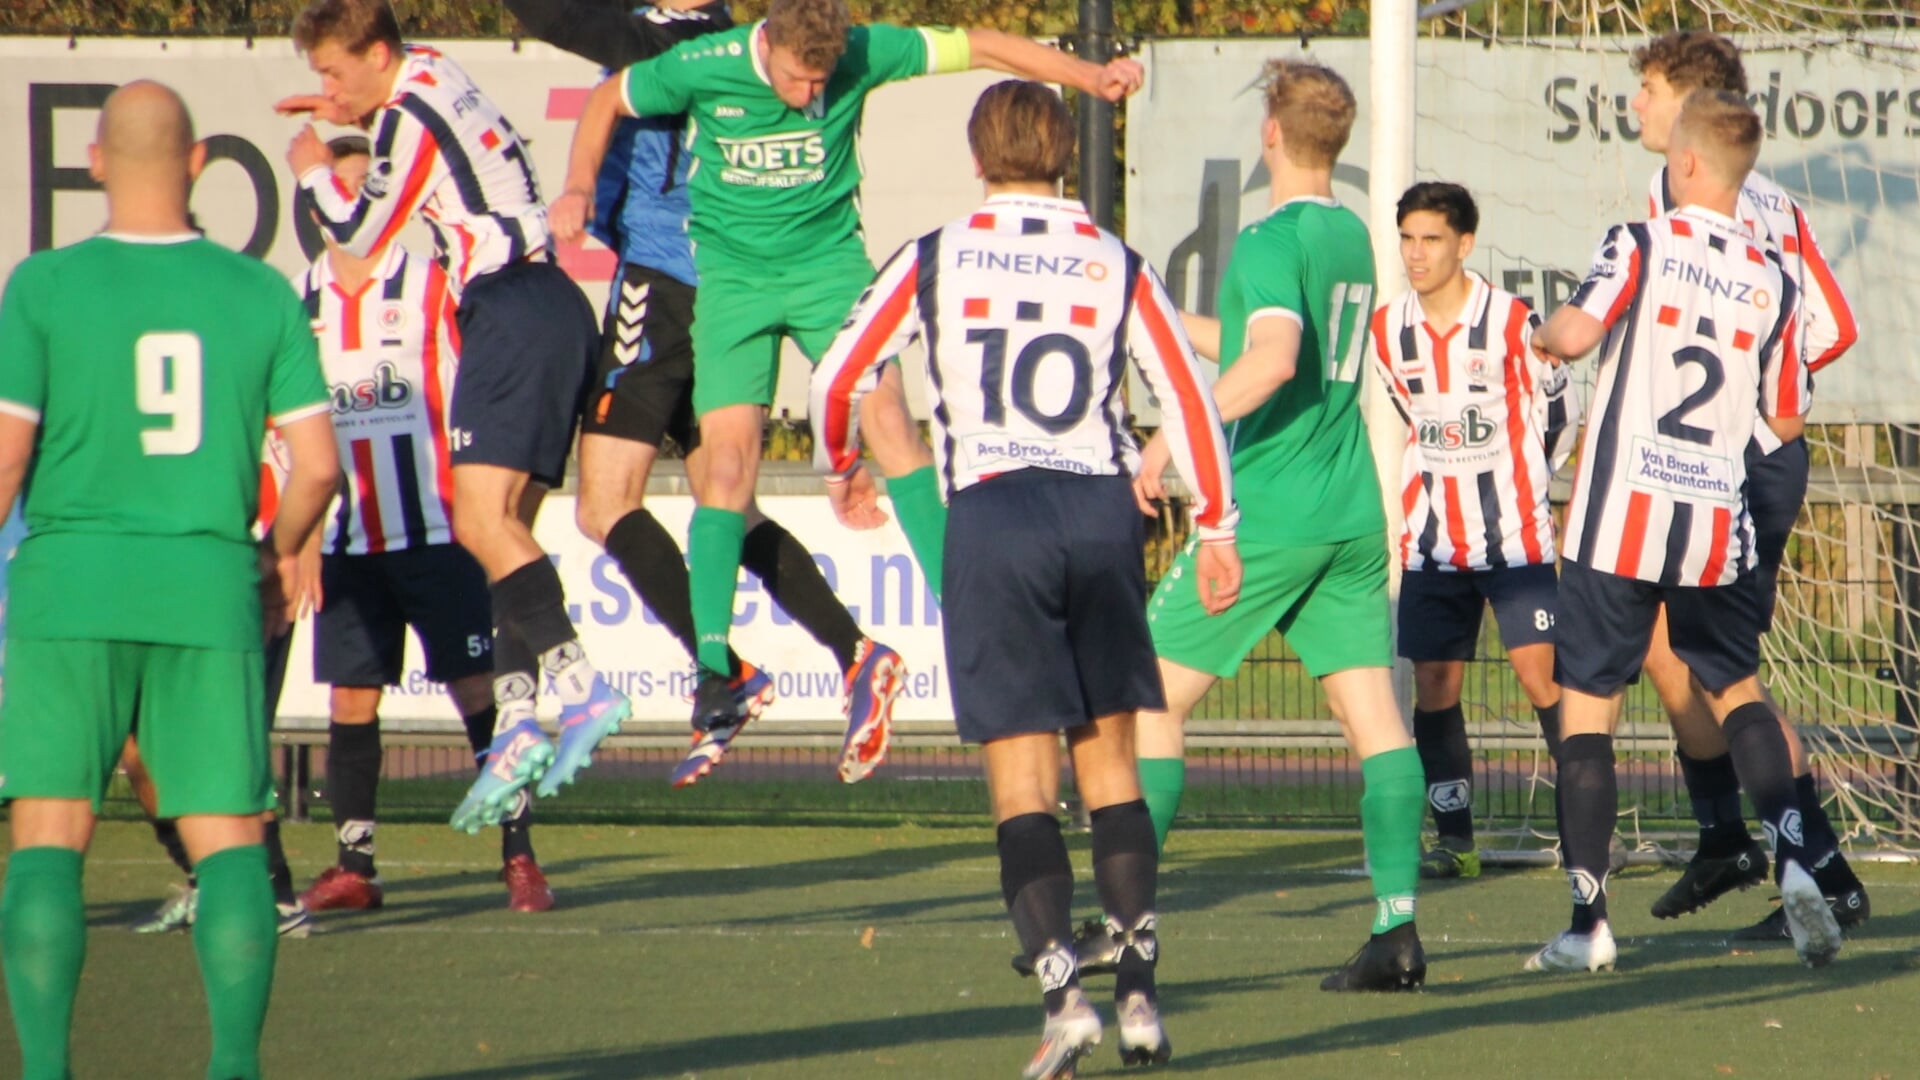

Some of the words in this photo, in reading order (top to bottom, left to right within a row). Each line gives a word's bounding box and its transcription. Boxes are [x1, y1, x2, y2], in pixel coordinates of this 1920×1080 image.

[720, 136, 825, 169] VOETS
[956, 249, 1108, 281] FINENZO
[1326, 282, 1373, 384] 17
[135, 331, 203, 456] 9
[965, 327, 1094, 434] 10
[1657, 345, 1726, 446] 2
[1417, 403, 1498, 451] msb
[1640, 463, 1730, 493] Accountants
[1666, 455, 1709, 476] Braak
[1534, 609, 1550, 631] 8
[467, 634, 483, 657] 5
